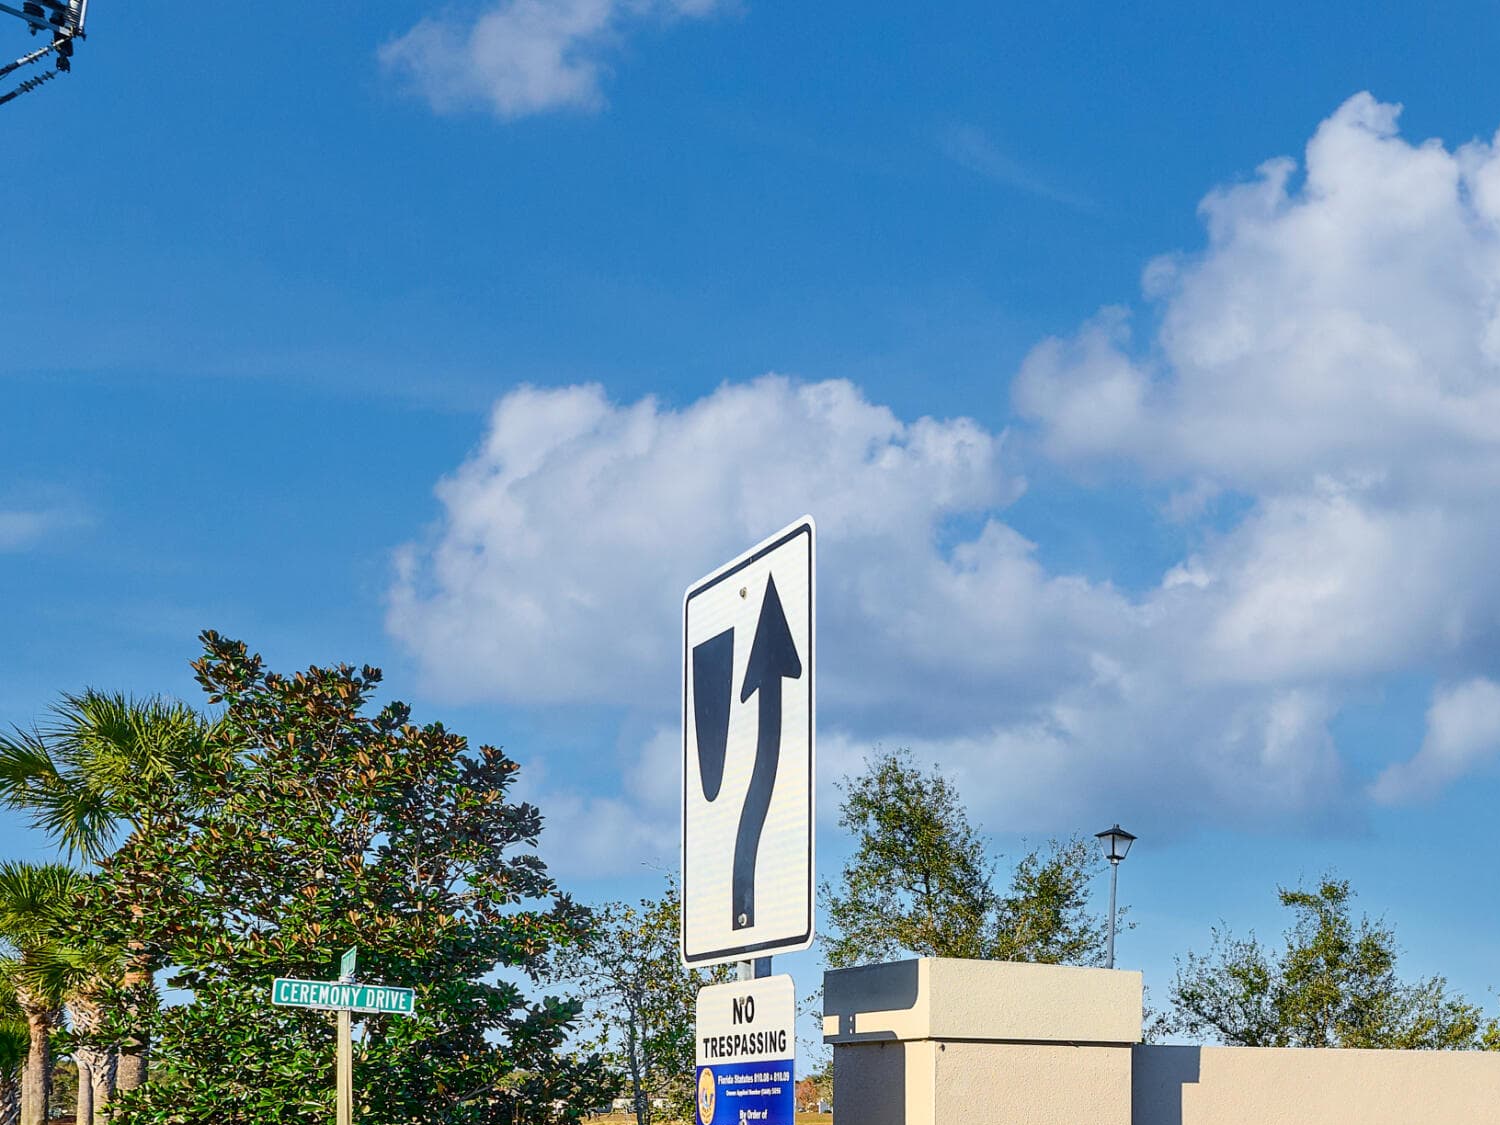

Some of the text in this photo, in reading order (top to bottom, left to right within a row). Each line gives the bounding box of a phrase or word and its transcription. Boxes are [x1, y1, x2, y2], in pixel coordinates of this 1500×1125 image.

[280, 982, 407, 1010] CEREMONY DRIVE
[733, 995, 755, 1025] NO
[703, 1029, 786, 1059] TRESPASSING
[762, 1109, 768, 1119] of
